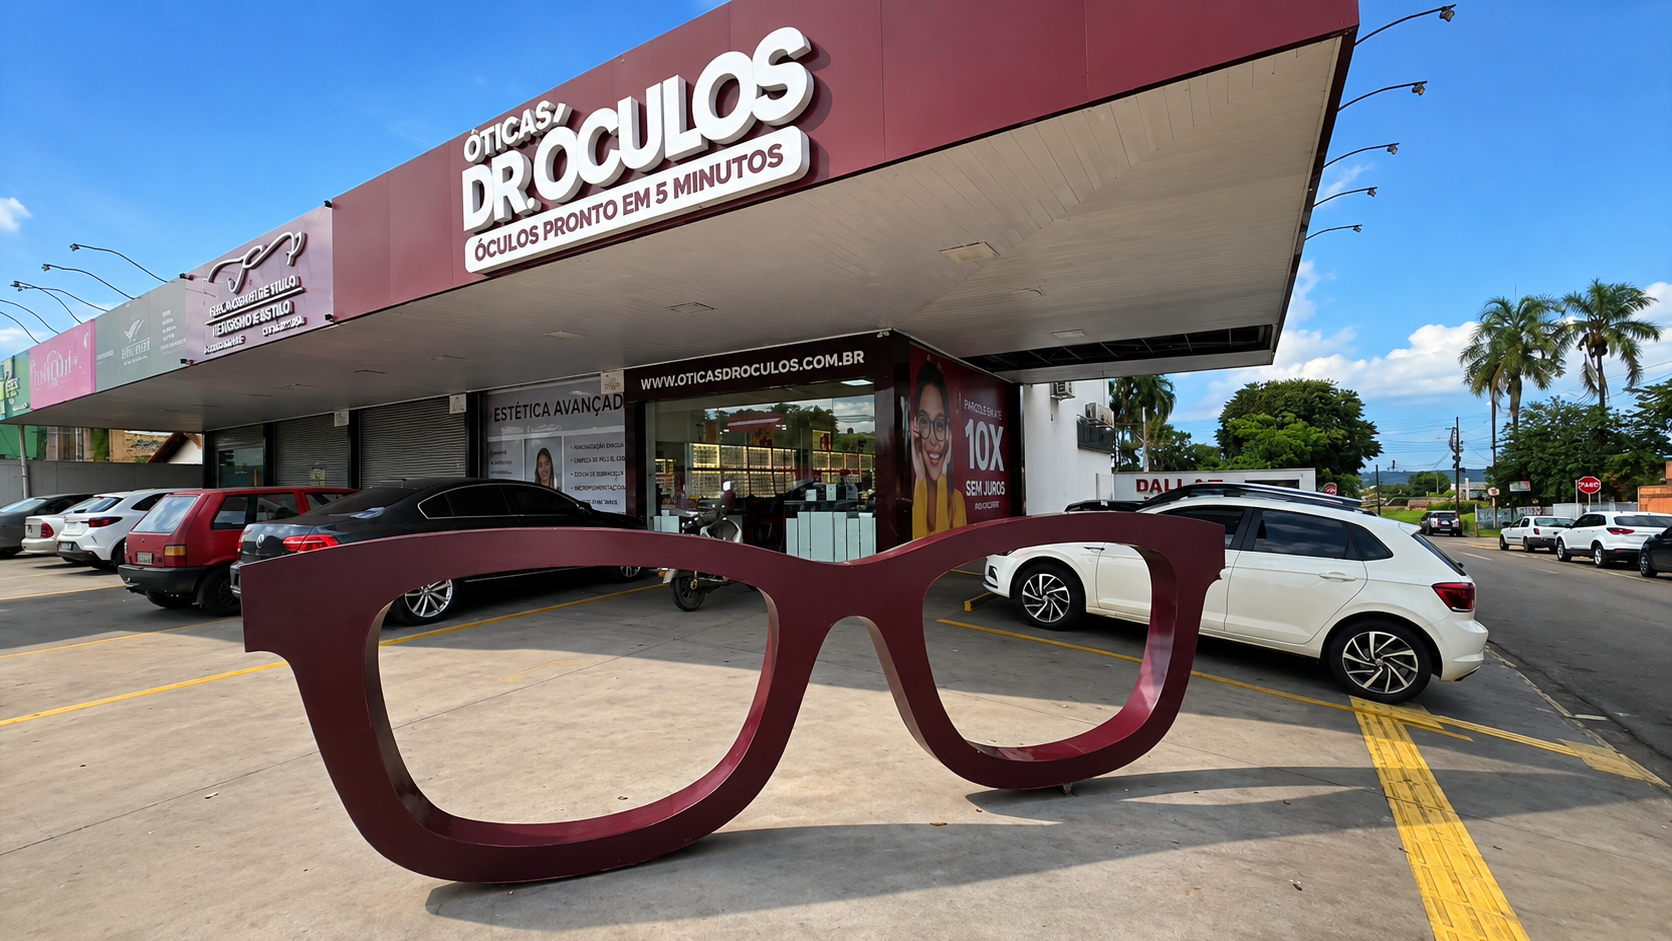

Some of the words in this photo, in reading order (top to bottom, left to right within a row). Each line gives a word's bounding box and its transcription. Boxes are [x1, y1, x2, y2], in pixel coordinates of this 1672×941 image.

[464, 99, 556, 164] ÓTICAS
[474, 225, 539, 261] ÓCULOS
[543, 200, 618, 241] PRONTO
[622, 182, 651, 216] EM
[655, 181, 668, 205] 5
[673, 143, 784, 199] MINUTOS
[640, 350, 865, 391] WWW.OTICASDROCULOS.COM.BR
[494, 401, 551, 422] ESTÉTICA
[965, 418, 1005, 472] 10X
[966, 480, 983, 497] SEM
[984, 480, 1006, 496] JUROS
[1136, 478, 1223, 493] DALL
